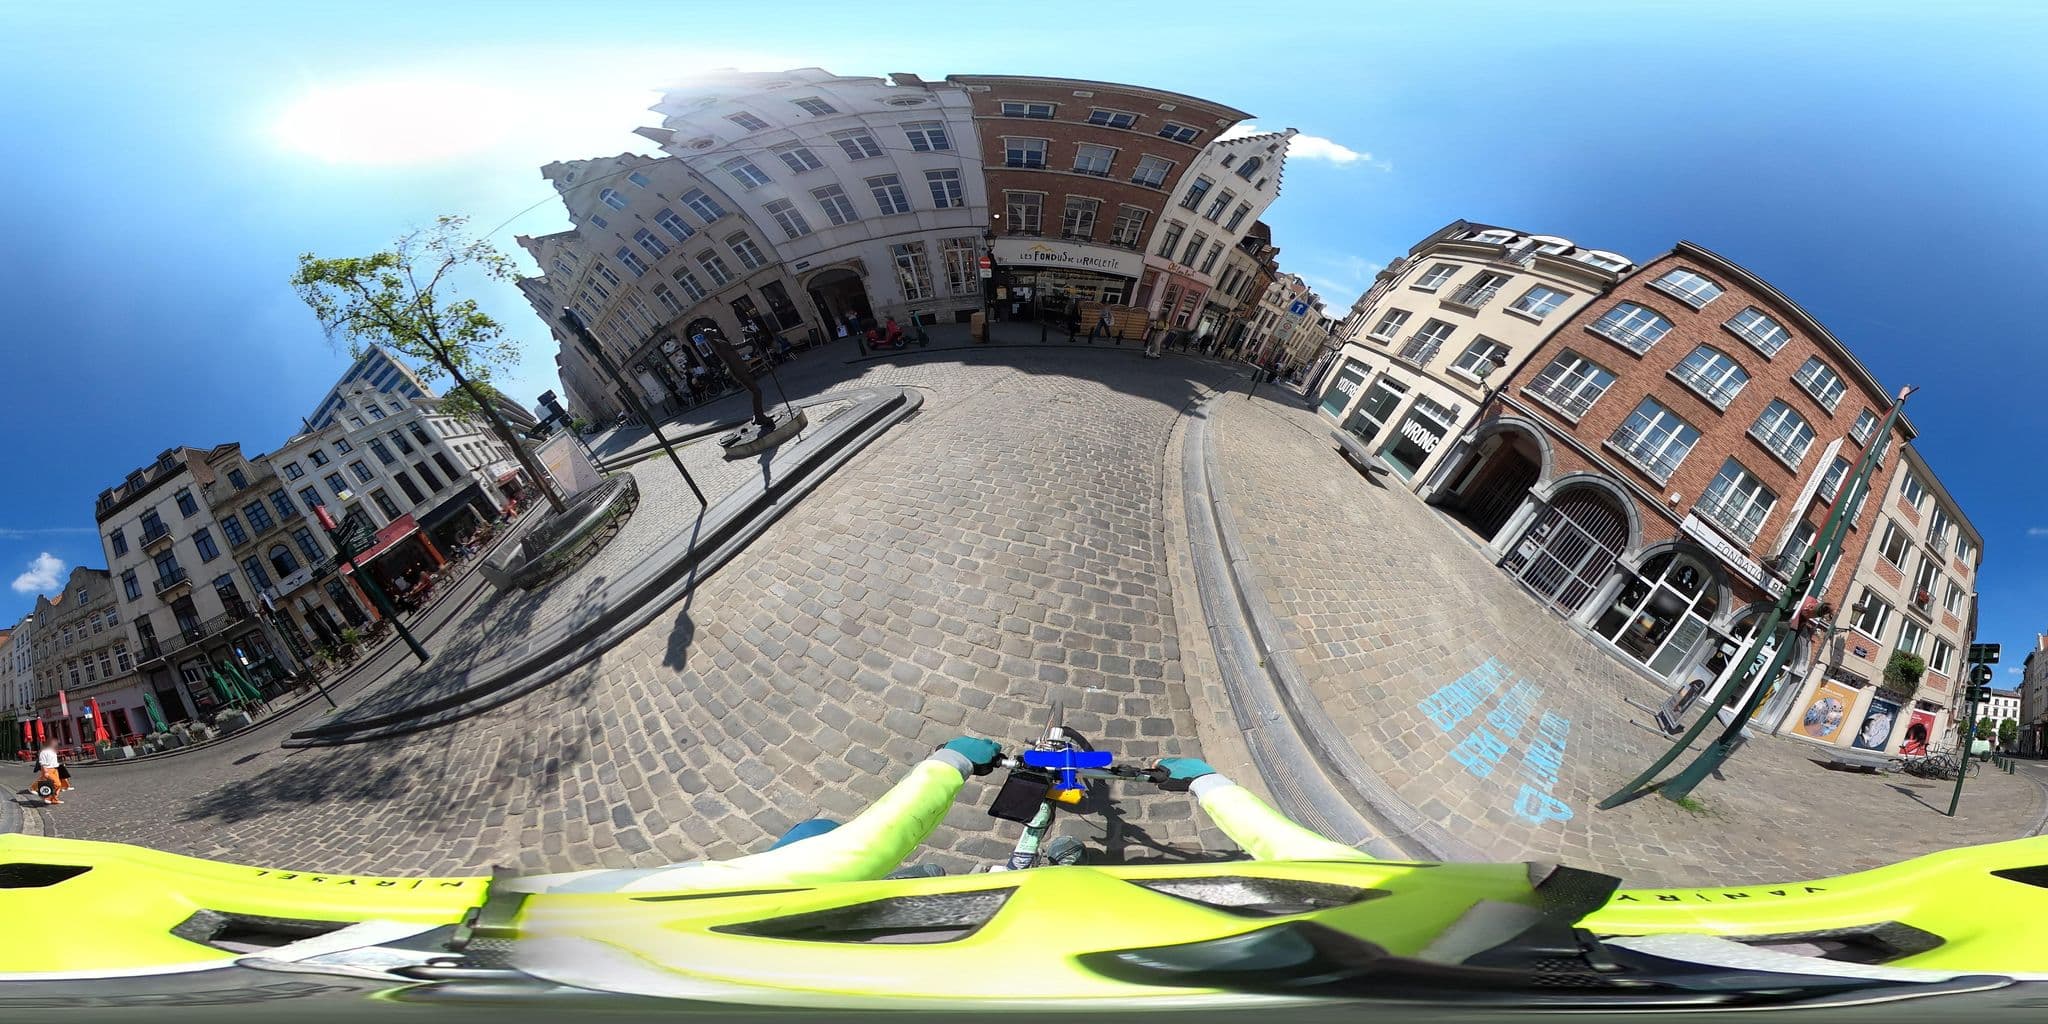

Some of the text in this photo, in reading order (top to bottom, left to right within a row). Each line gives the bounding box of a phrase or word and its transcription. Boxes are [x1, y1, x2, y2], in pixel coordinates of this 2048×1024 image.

[1034, 250, 1068, 262] FONDUS
[1083, 256, 1120, 269] RACLETTE
[1401, 418, 1440, 453] WRONG
[1716, 541, 1770, 588] FONDATION
[1449, 724, 1509, 778] PAR
